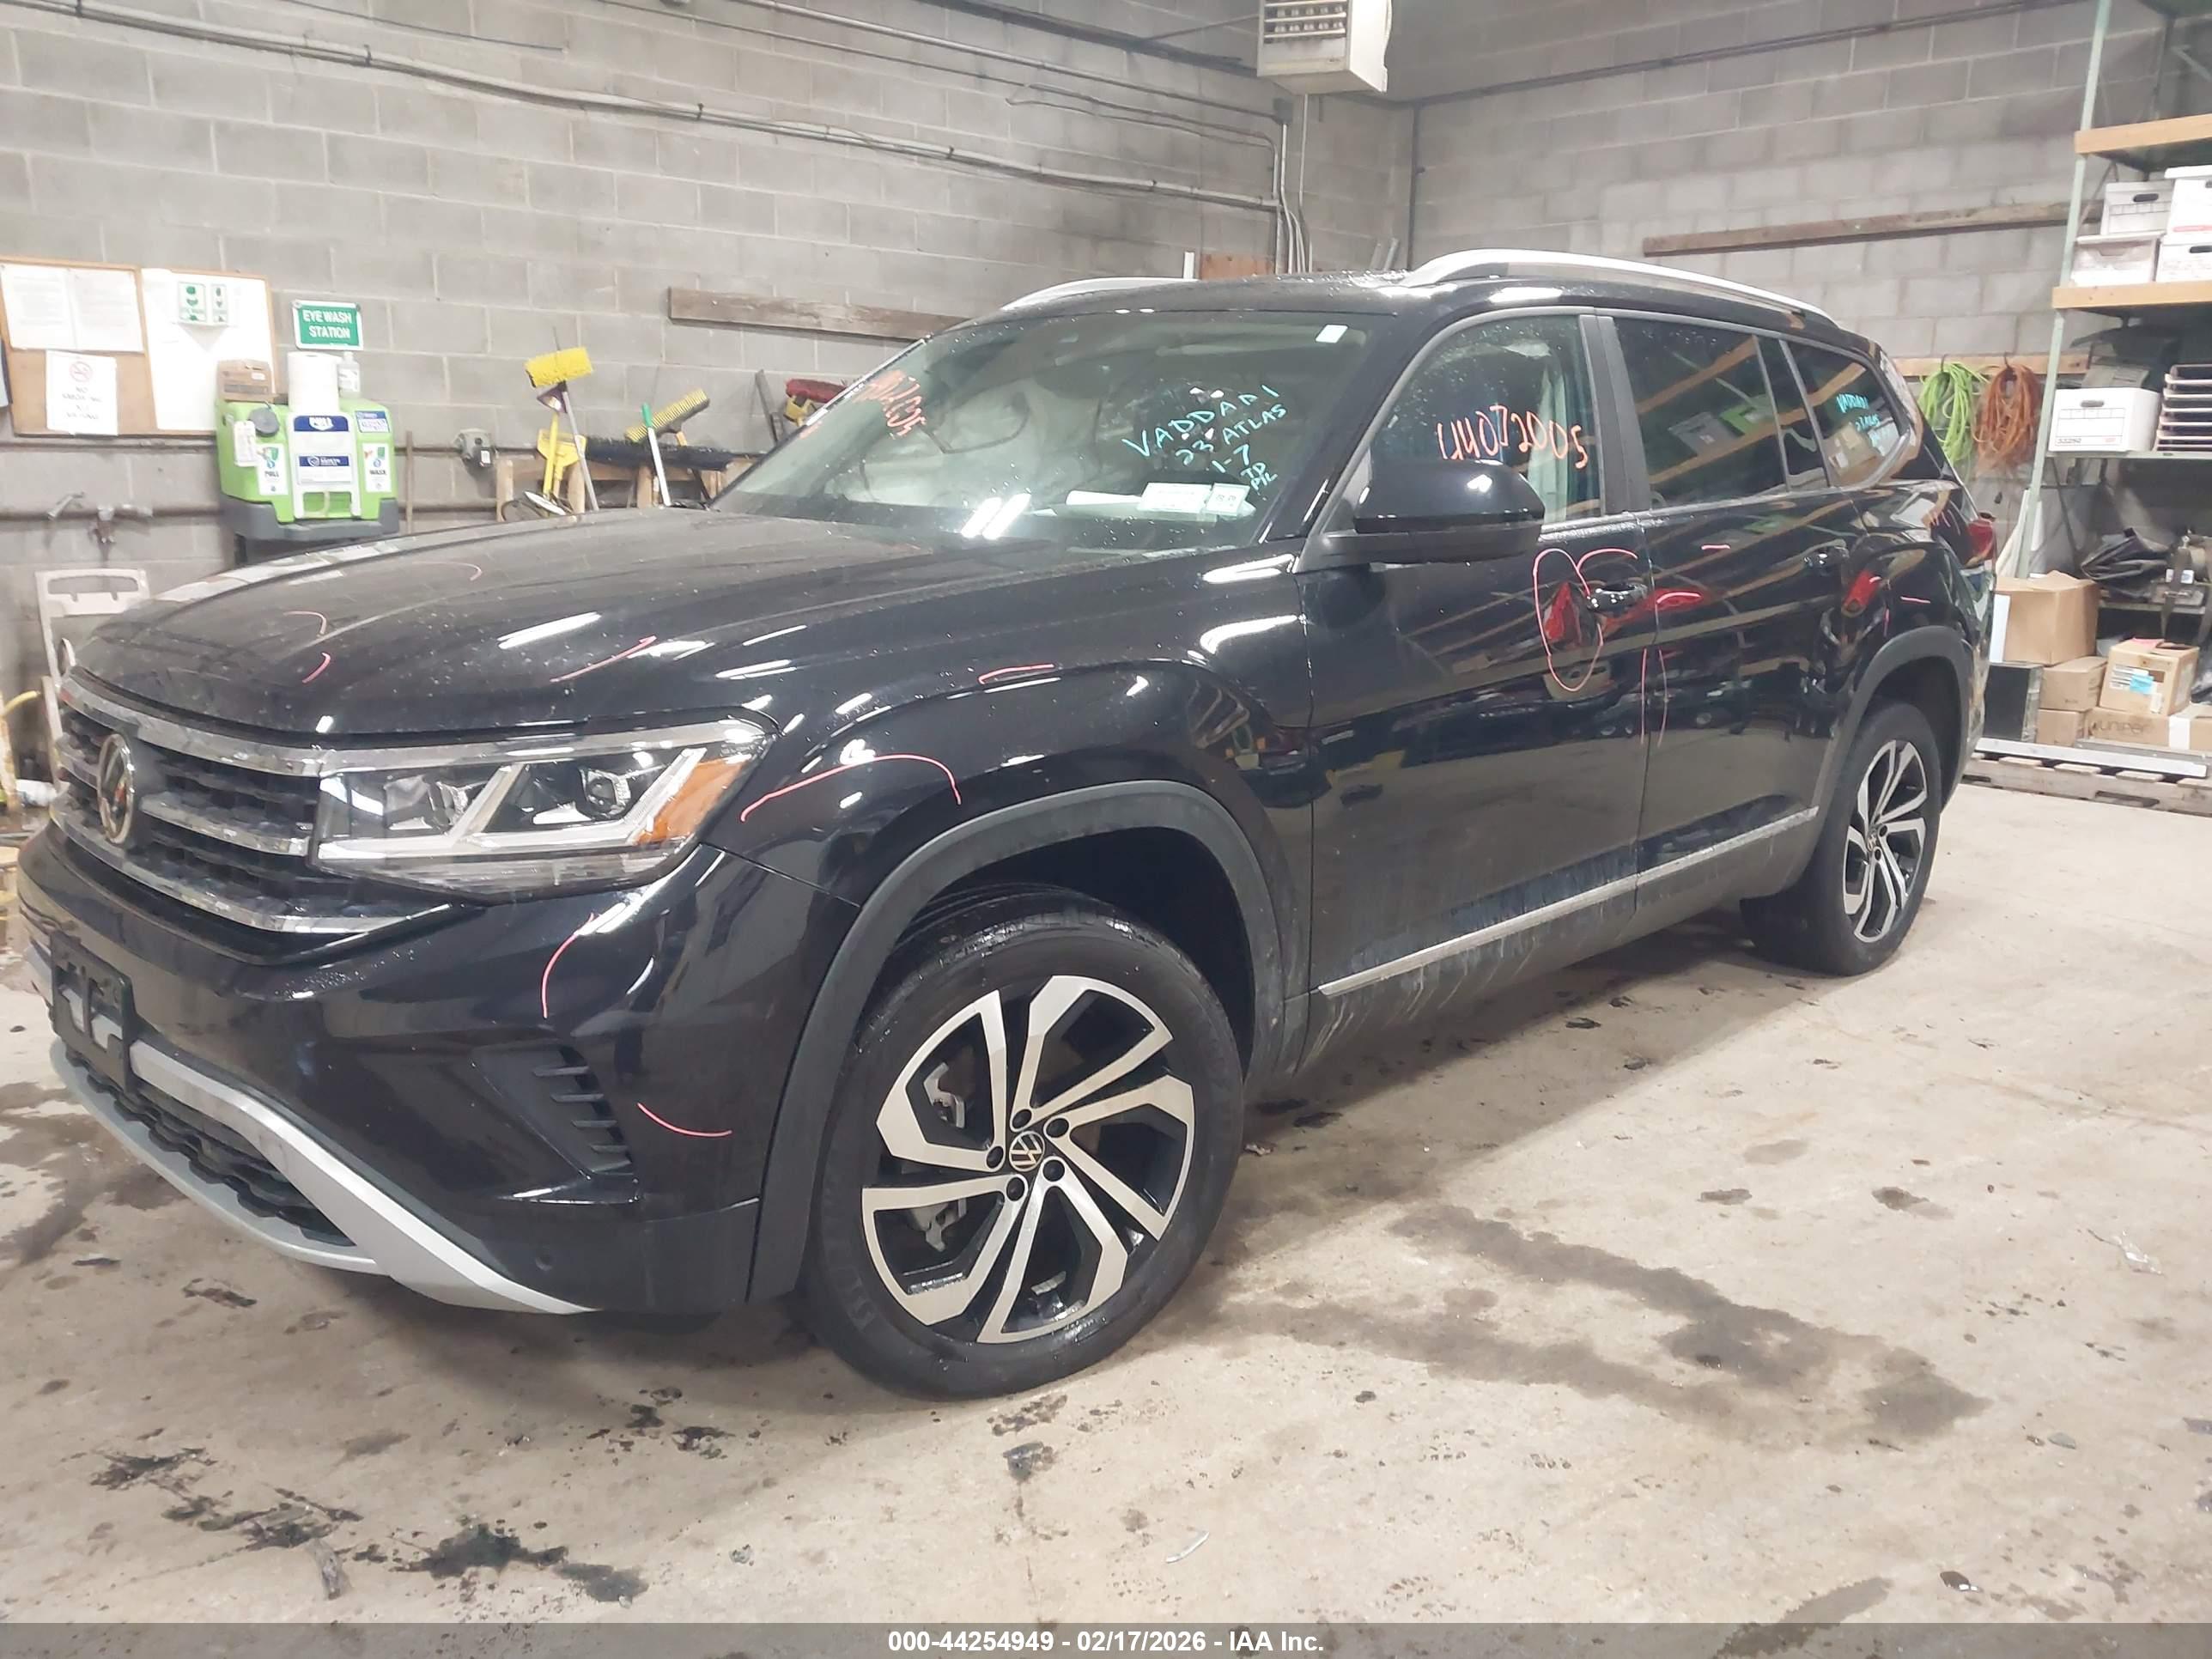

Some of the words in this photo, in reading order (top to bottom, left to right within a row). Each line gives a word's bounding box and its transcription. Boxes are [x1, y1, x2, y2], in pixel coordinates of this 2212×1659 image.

[301, 309, 323, 323] EYE
[323, 310, 352, 324] WASH
[308, 325, 351, 339] STATION
[1221, 403, 1287, 446] ATLAS
